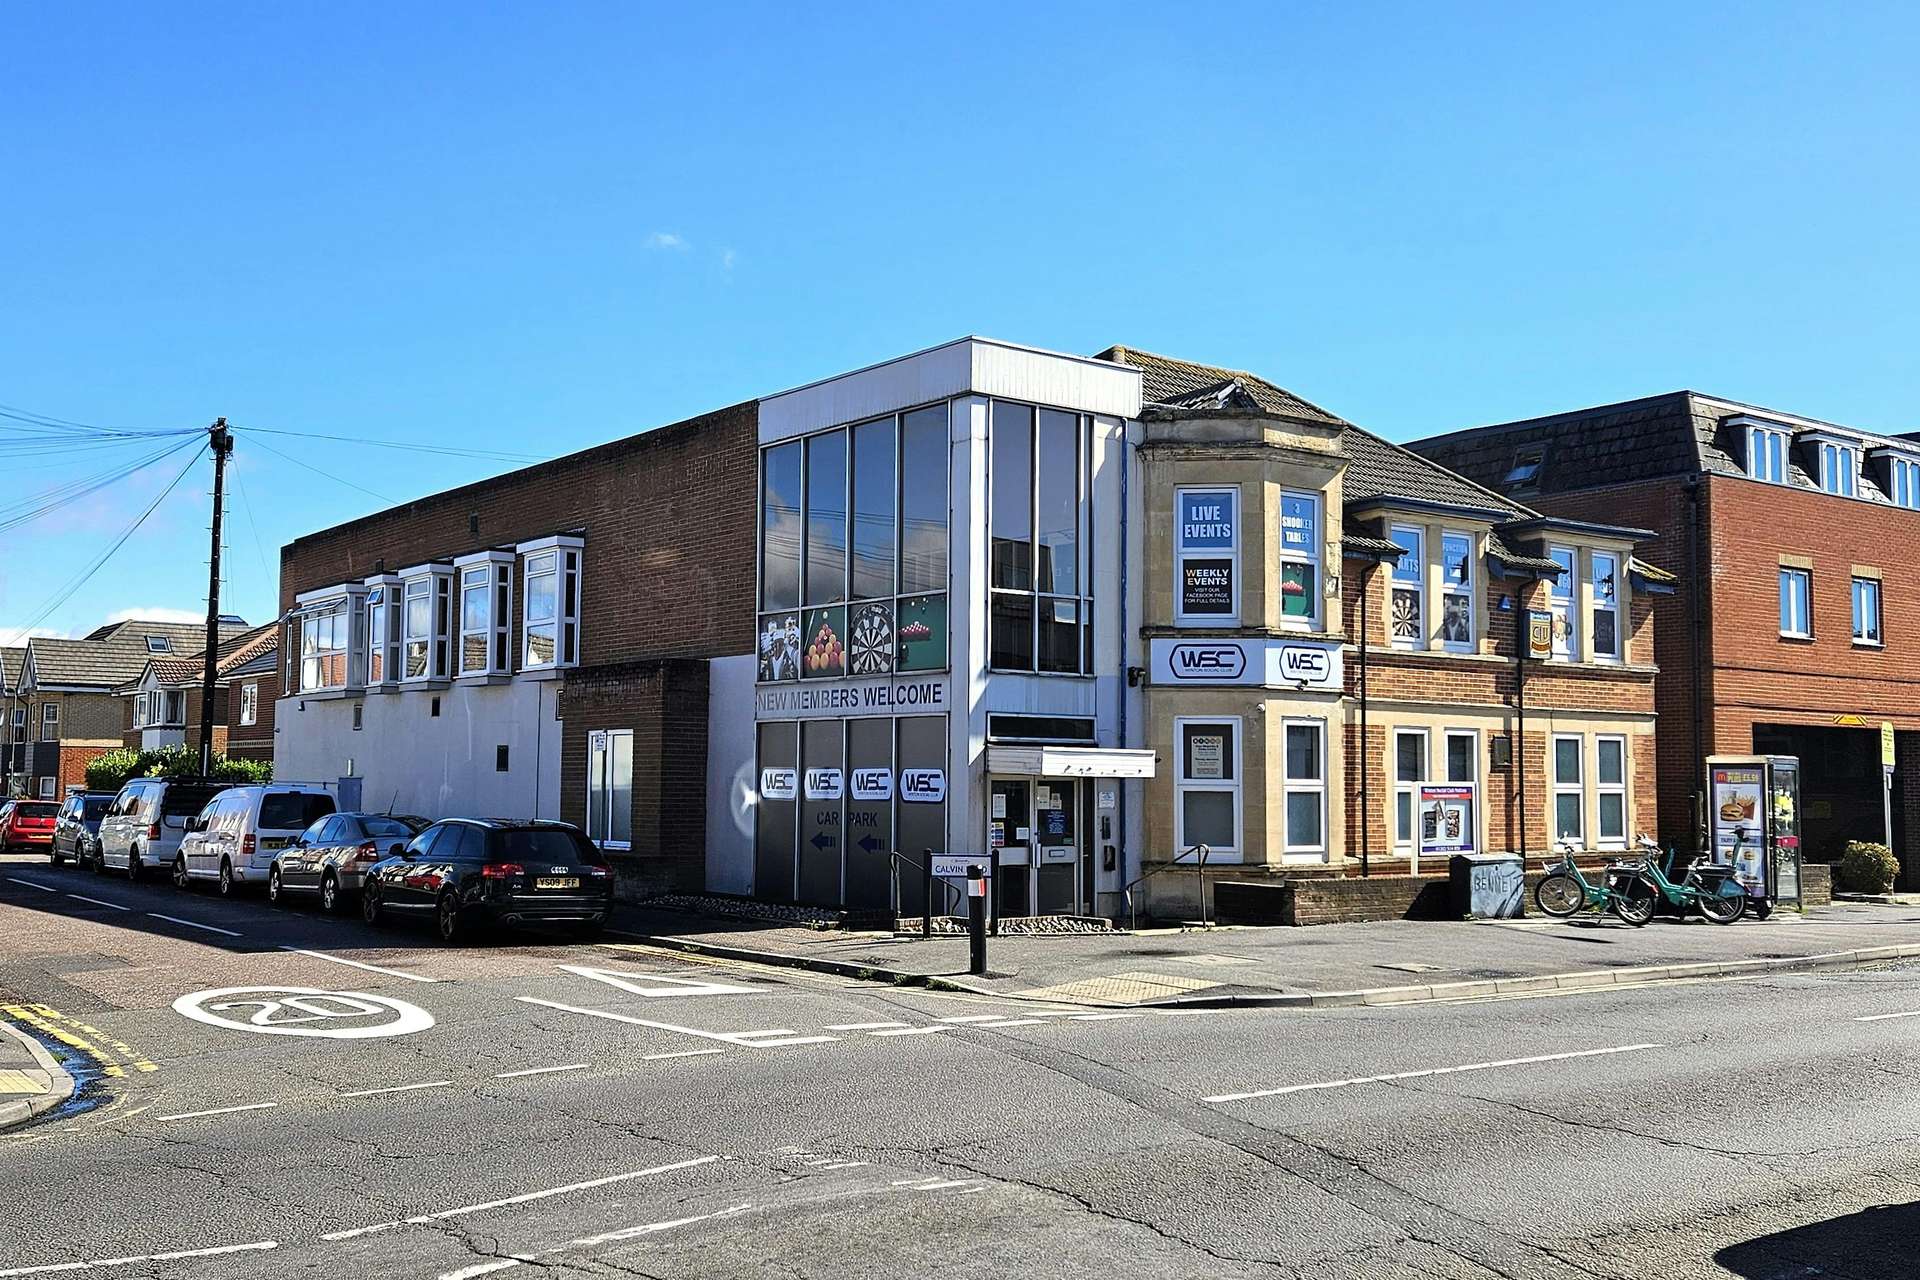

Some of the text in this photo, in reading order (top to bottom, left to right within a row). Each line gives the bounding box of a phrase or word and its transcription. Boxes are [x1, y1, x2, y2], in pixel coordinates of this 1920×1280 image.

[1191, 505, 1221, 521] LIVE
[1184, 523, 1231, 538] EVENTS
[1185, 569, 1229, 577] WEEKLY
[1187, 577, 1228, 586] EVENTS
[1181, 651, 1236, 668] WSC
[1287, 652, 1324, 671] WSC
[757, 683, 943, 711] NEW MEMBERS WELCOME
[765, 773, 794, 790] WSC
[809, 773, 840, 791] WSC
[855, 773, 889, 791] WSC
[905, 773, 941, 793] WSC
[817, 811, 878, 827] CAR PARK
[935, 865, 964, 873] CALVIN
[209, 995, 384, 1026] 20
